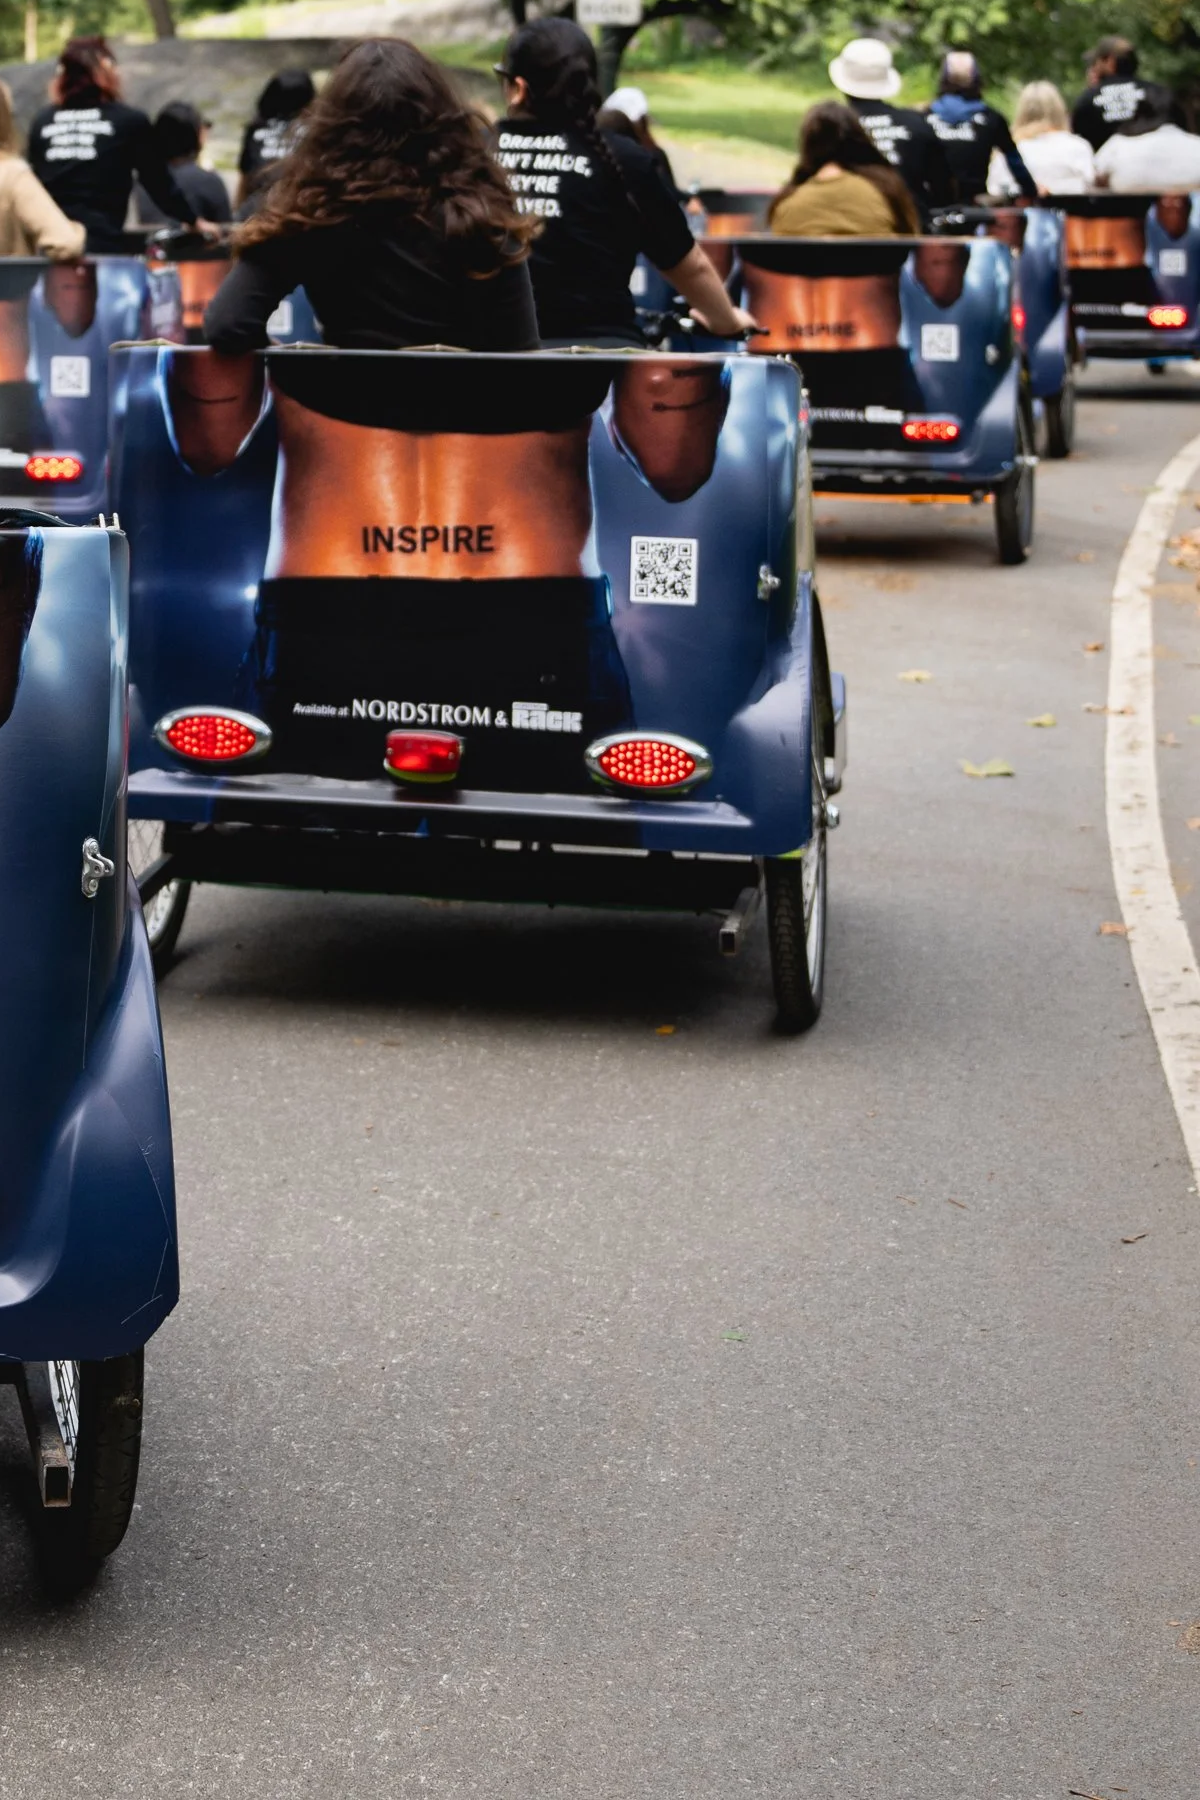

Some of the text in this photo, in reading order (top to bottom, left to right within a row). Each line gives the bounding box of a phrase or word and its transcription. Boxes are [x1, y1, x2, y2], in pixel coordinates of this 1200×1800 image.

[362, 525, 495, 553] INSPIRE
[293, 702, 336, 717] Available
[338, 706, 349, 717] at
[352, 699, 491, 727] NORDSTROM
[494, 710, 508, 727] &
